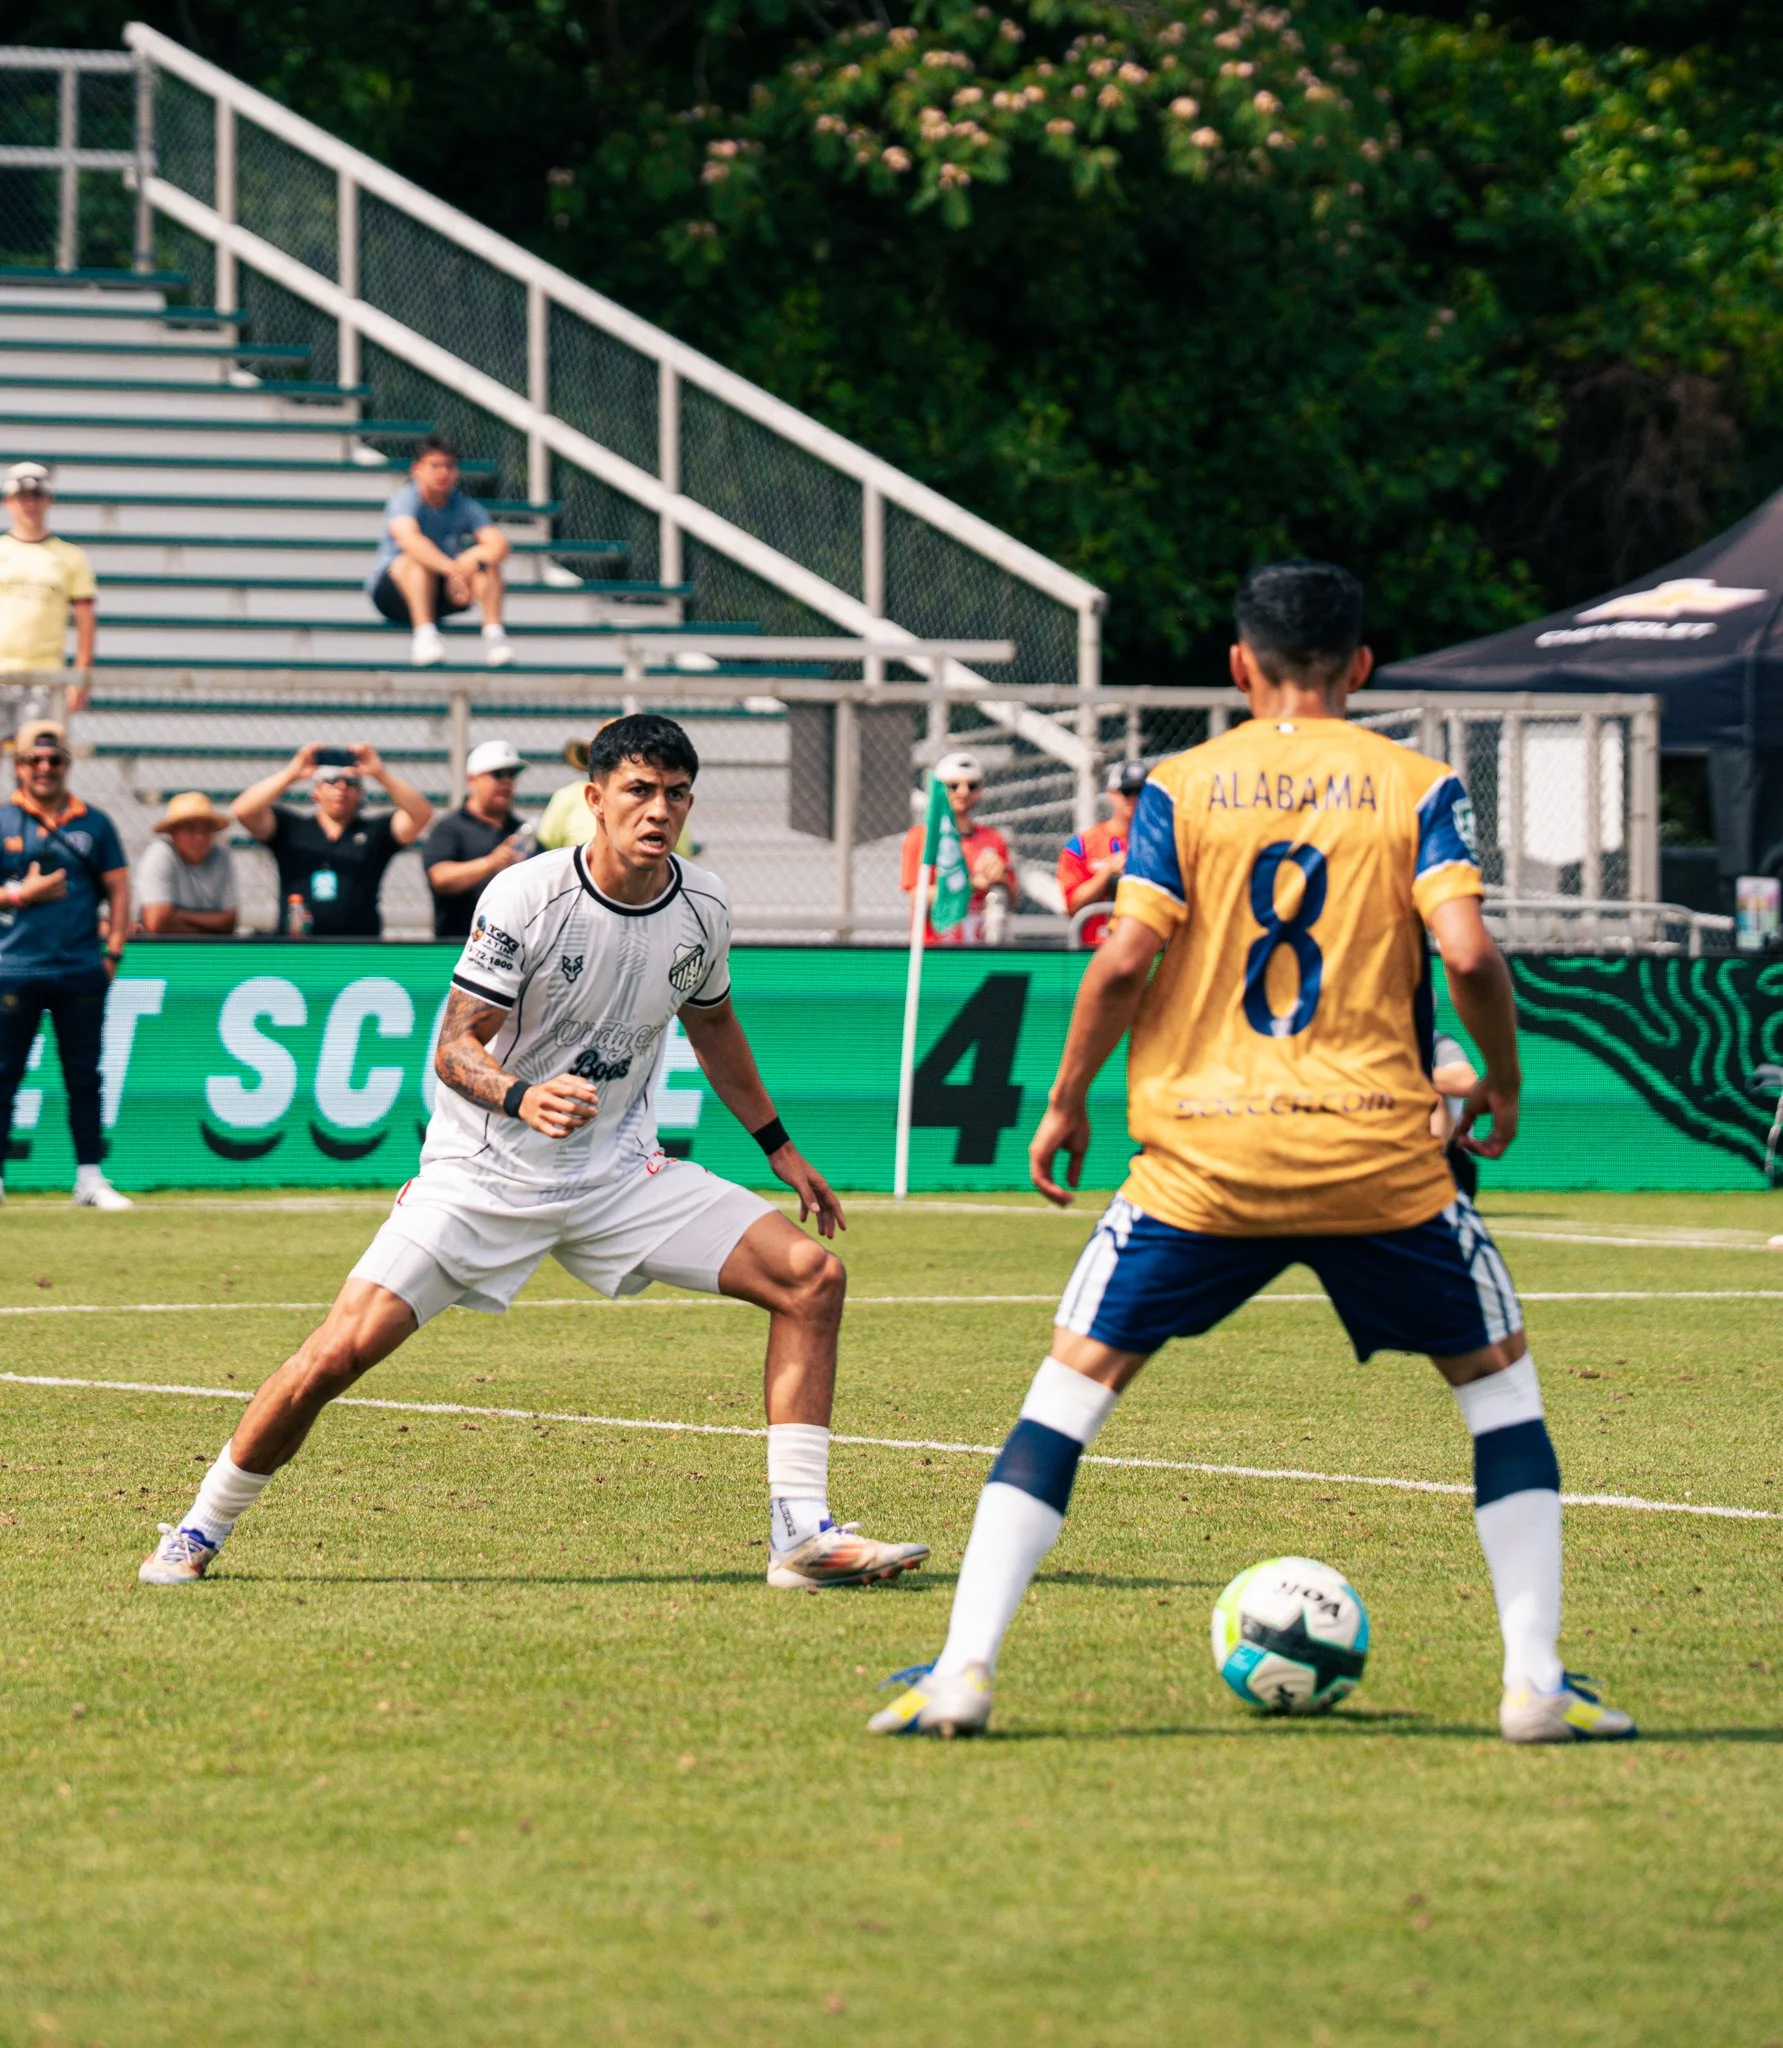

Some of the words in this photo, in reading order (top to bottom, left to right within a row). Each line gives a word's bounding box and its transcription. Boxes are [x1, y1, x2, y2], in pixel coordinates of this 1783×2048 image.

[1208, 771, 1378, 813] ALABAMA
[1242, 840, 1328, 1039] 8
[898, 971, 1033, 1167] 4
